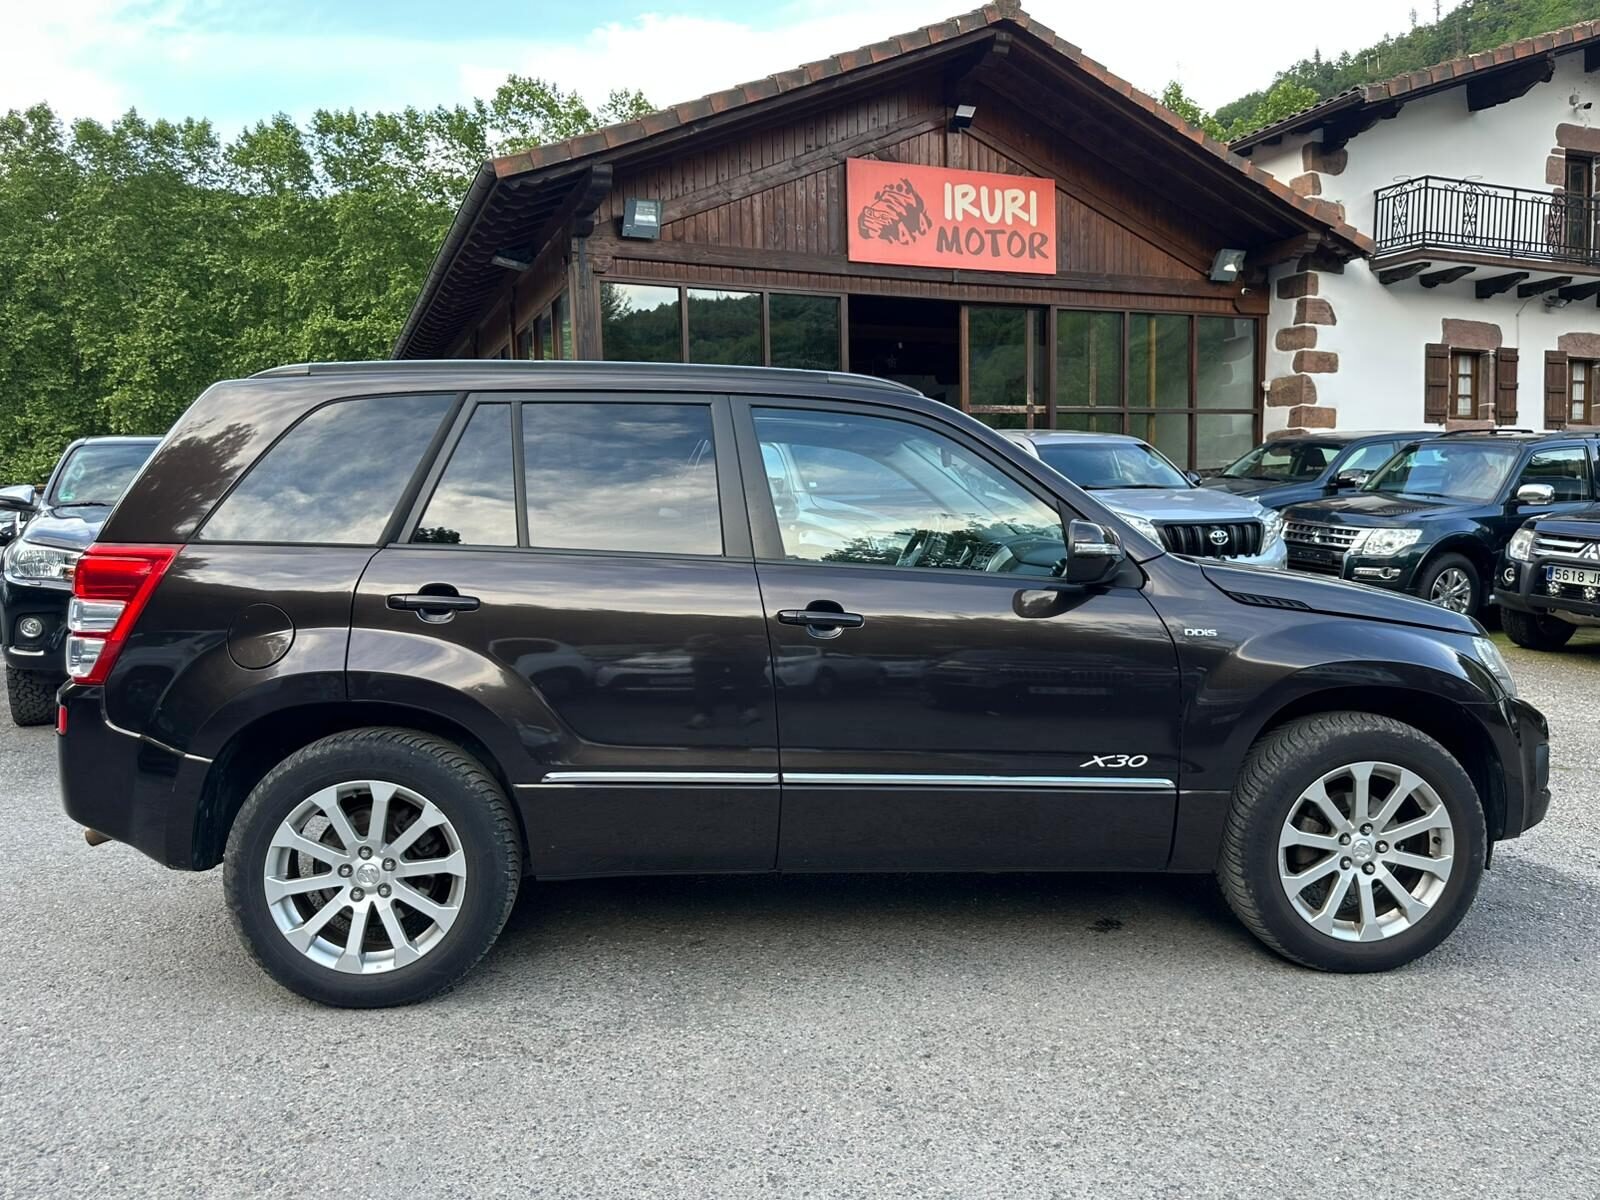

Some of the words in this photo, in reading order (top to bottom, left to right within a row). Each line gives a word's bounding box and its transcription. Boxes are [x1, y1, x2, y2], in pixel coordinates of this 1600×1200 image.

[944, 182, 1037, 227] IRURI
[936, 226, 1049, 259] MOTOR
[1555, 568, 1585, 582] 5618
[1080, 754, 1149, 768] X30
